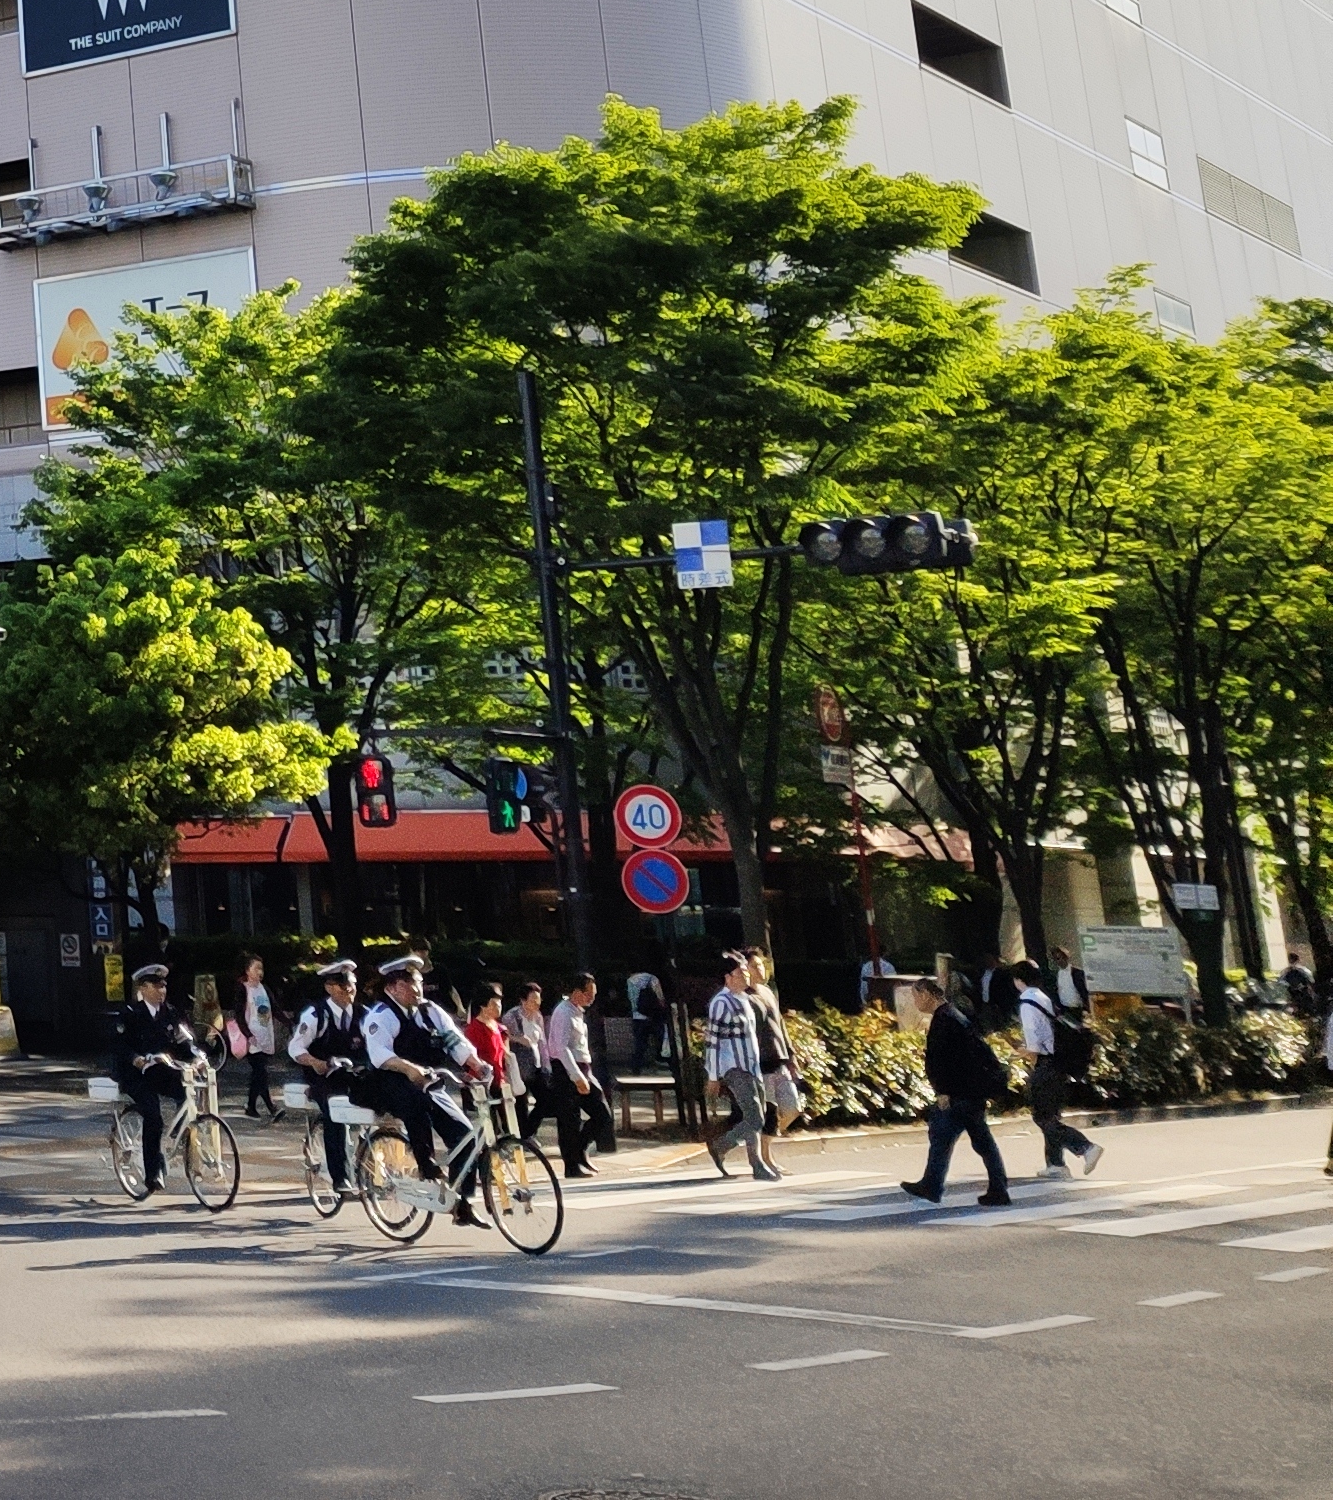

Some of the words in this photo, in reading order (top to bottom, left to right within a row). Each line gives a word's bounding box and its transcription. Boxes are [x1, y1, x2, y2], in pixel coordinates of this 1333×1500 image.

[69, 35, 93, 50] THE
[95, 28, 122, 45] SUIT
[123, 15, 183, 39] COMPANY
[681, 570, 730, 587] 時差式
[632, 804, 665, 830] 40
